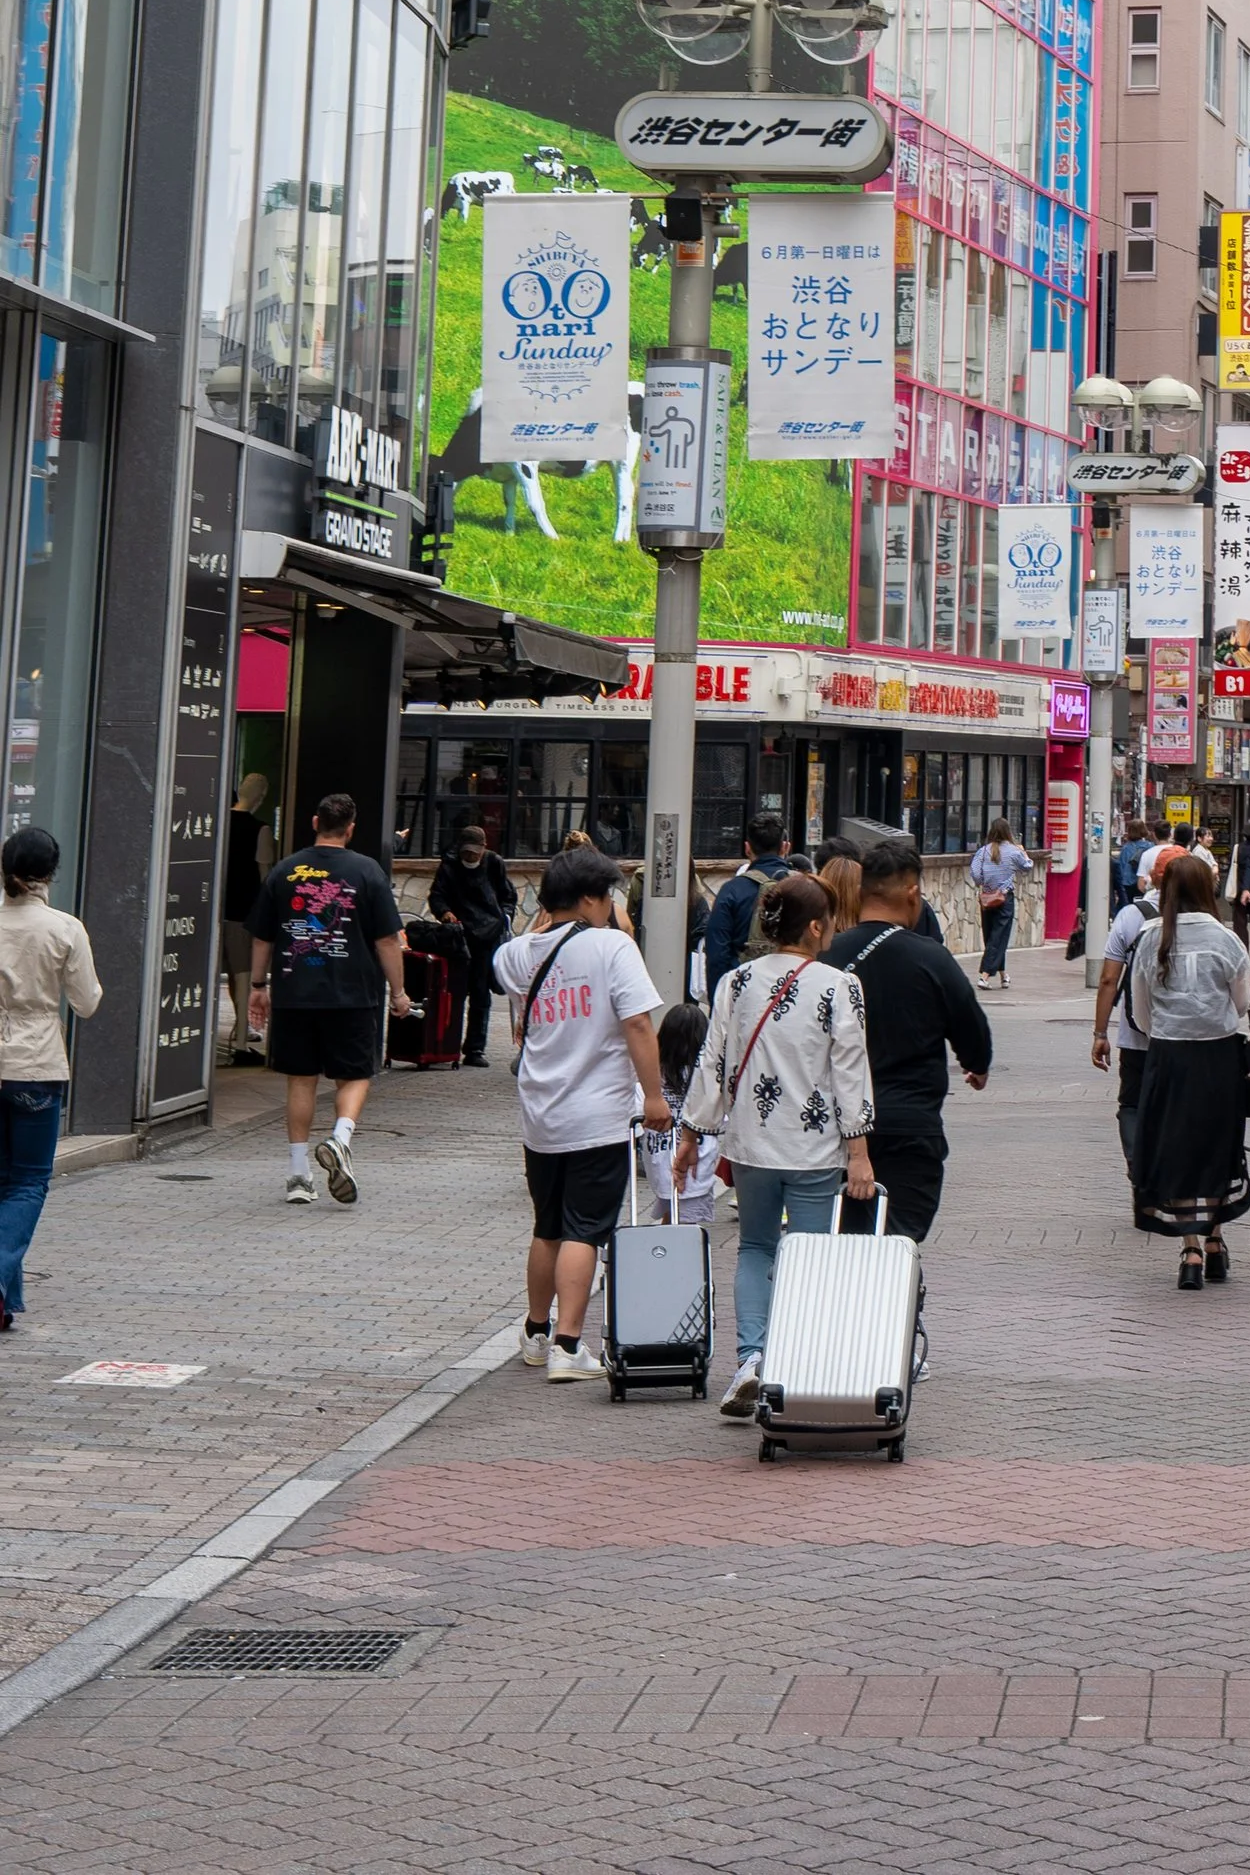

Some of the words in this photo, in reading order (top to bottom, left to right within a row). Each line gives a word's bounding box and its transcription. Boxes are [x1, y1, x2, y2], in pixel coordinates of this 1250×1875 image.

[629, 116, 869, 148] 渋谷センター街
[528, 251, 586, 269] SHIBUYA
[761, 245, 881, 260] 6月第一日曜日は
[792, 276, 853, 304] 渋谷
[761, 312, 880, 339] おとなり
[499, 338, 613, 367] Sunday
[761, 346, 882, 375] サンデー
[511, 423, 599, 436] 渋谷センター街
[778, 421, 865, 434] 渋谷センター街
[326, 405, 401, 492] ABC-MART
[1073, 465, 1190, 481] 渋谷センター街
[325, 511, 363, 551] GRAND
[362, 523, 393, 558] STAGE
[1151, 545, 1182, 560] 渋谷
[1137, 564, 1197, 578] おとなり
[1007, 577, 1064, 592] Sunday
[1136, 581, 1197, 596] サンデー
[1225, 676, 1244, 693] B1
[556, 703, 615, 712] TIMELESS
[286, 865, 330, 882] Japan
